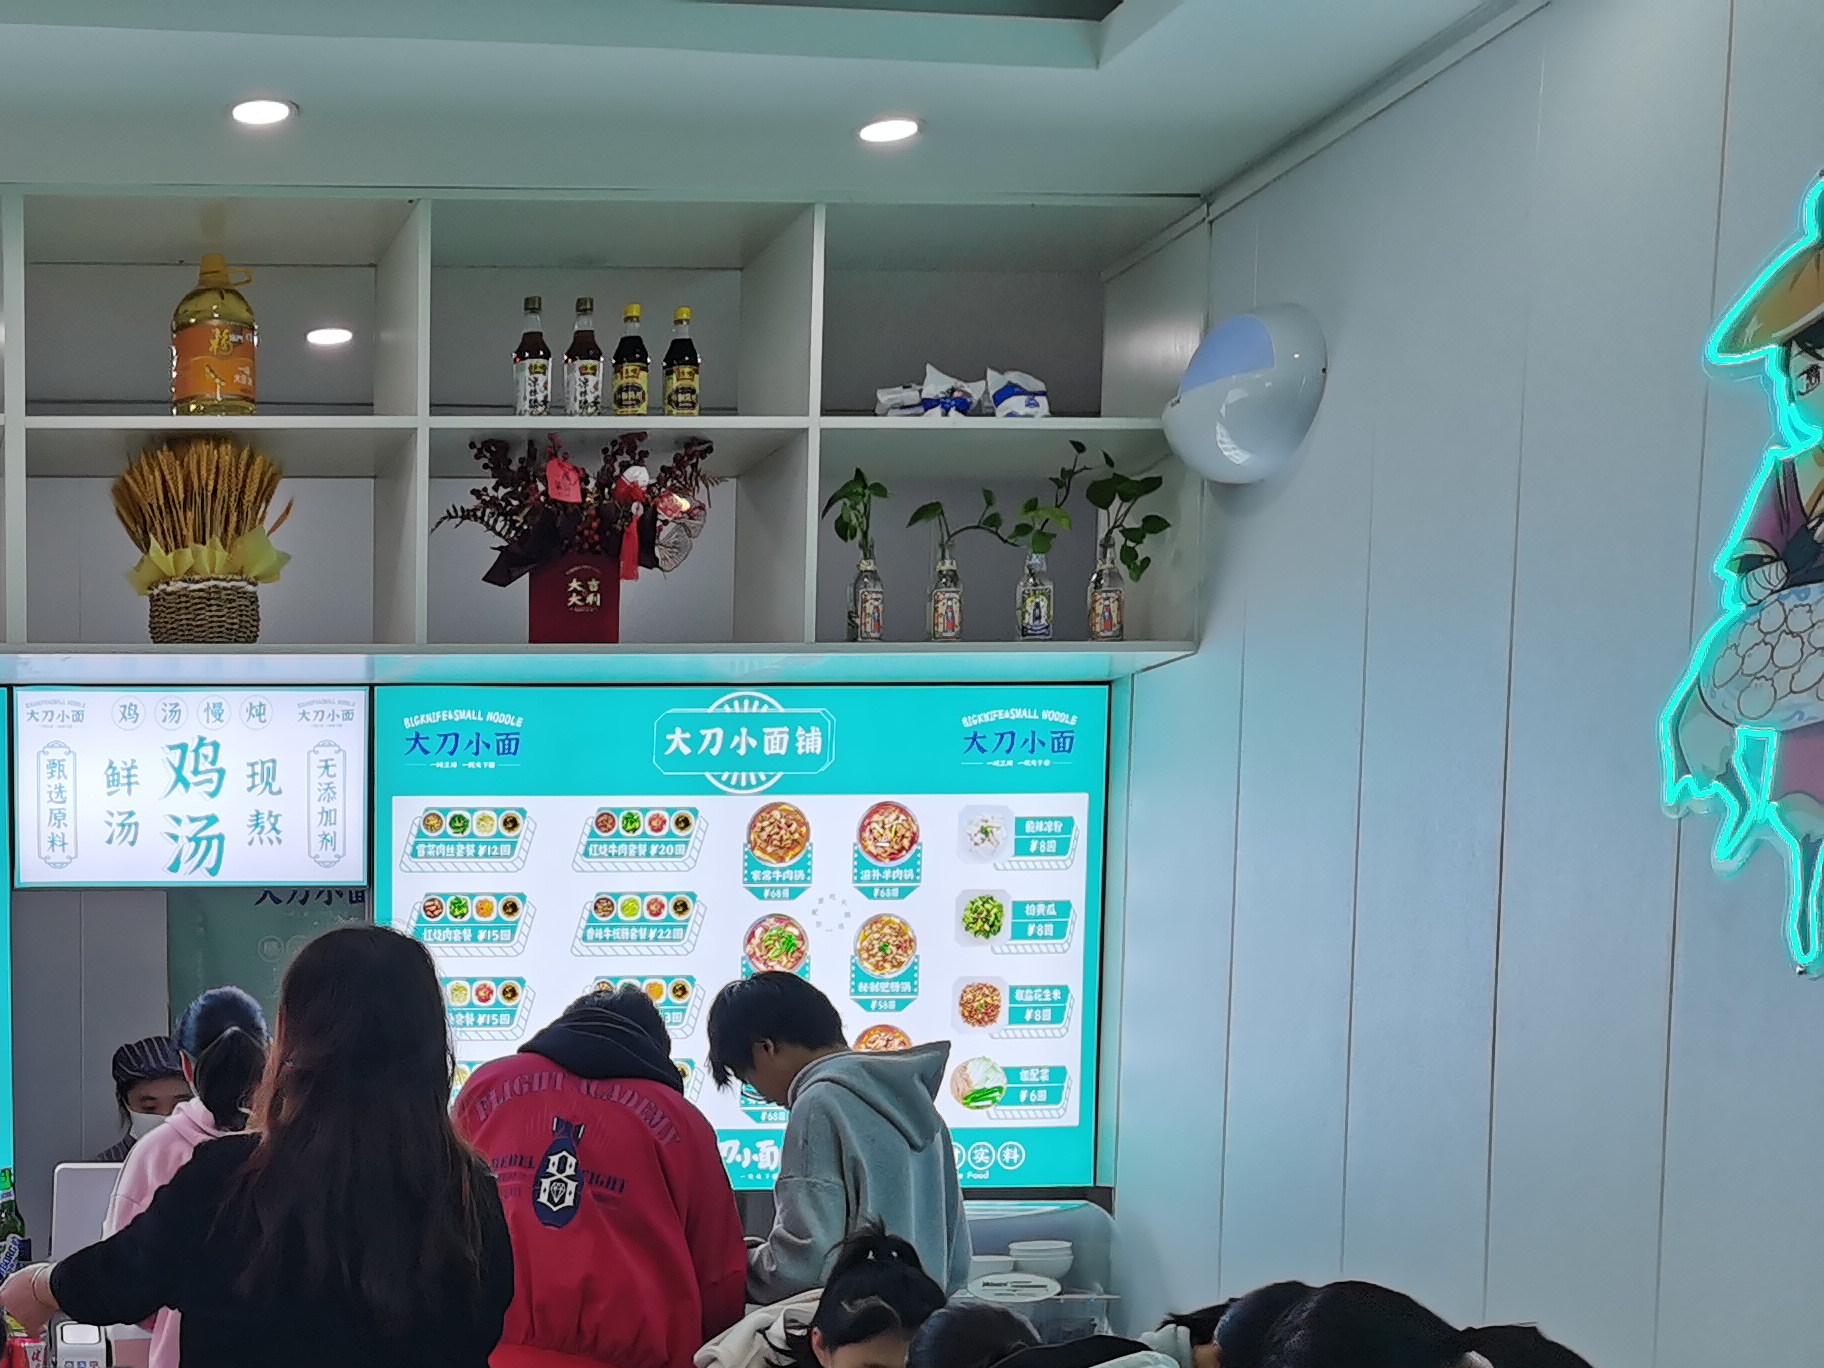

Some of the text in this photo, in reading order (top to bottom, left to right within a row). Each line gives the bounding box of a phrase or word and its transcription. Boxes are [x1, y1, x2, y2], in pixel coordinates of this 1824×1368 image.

[26, 709, 85, 723] 大刀小面
[118, 702, 267, 724] 鸡汤慢炖
[297, 709, 355, 722] 大刀小面
[404, 731, 521, 757] 大刀小面
[664, 726, 824, 757] 大刀小面铺
[963, 729, 1075, 755] 大刀小面
[46, 757, 69, 854] 甄选原料
[317, 757, 338, 853] 无添加剂
[478, 1071, 570, 1122] FLIGHT
